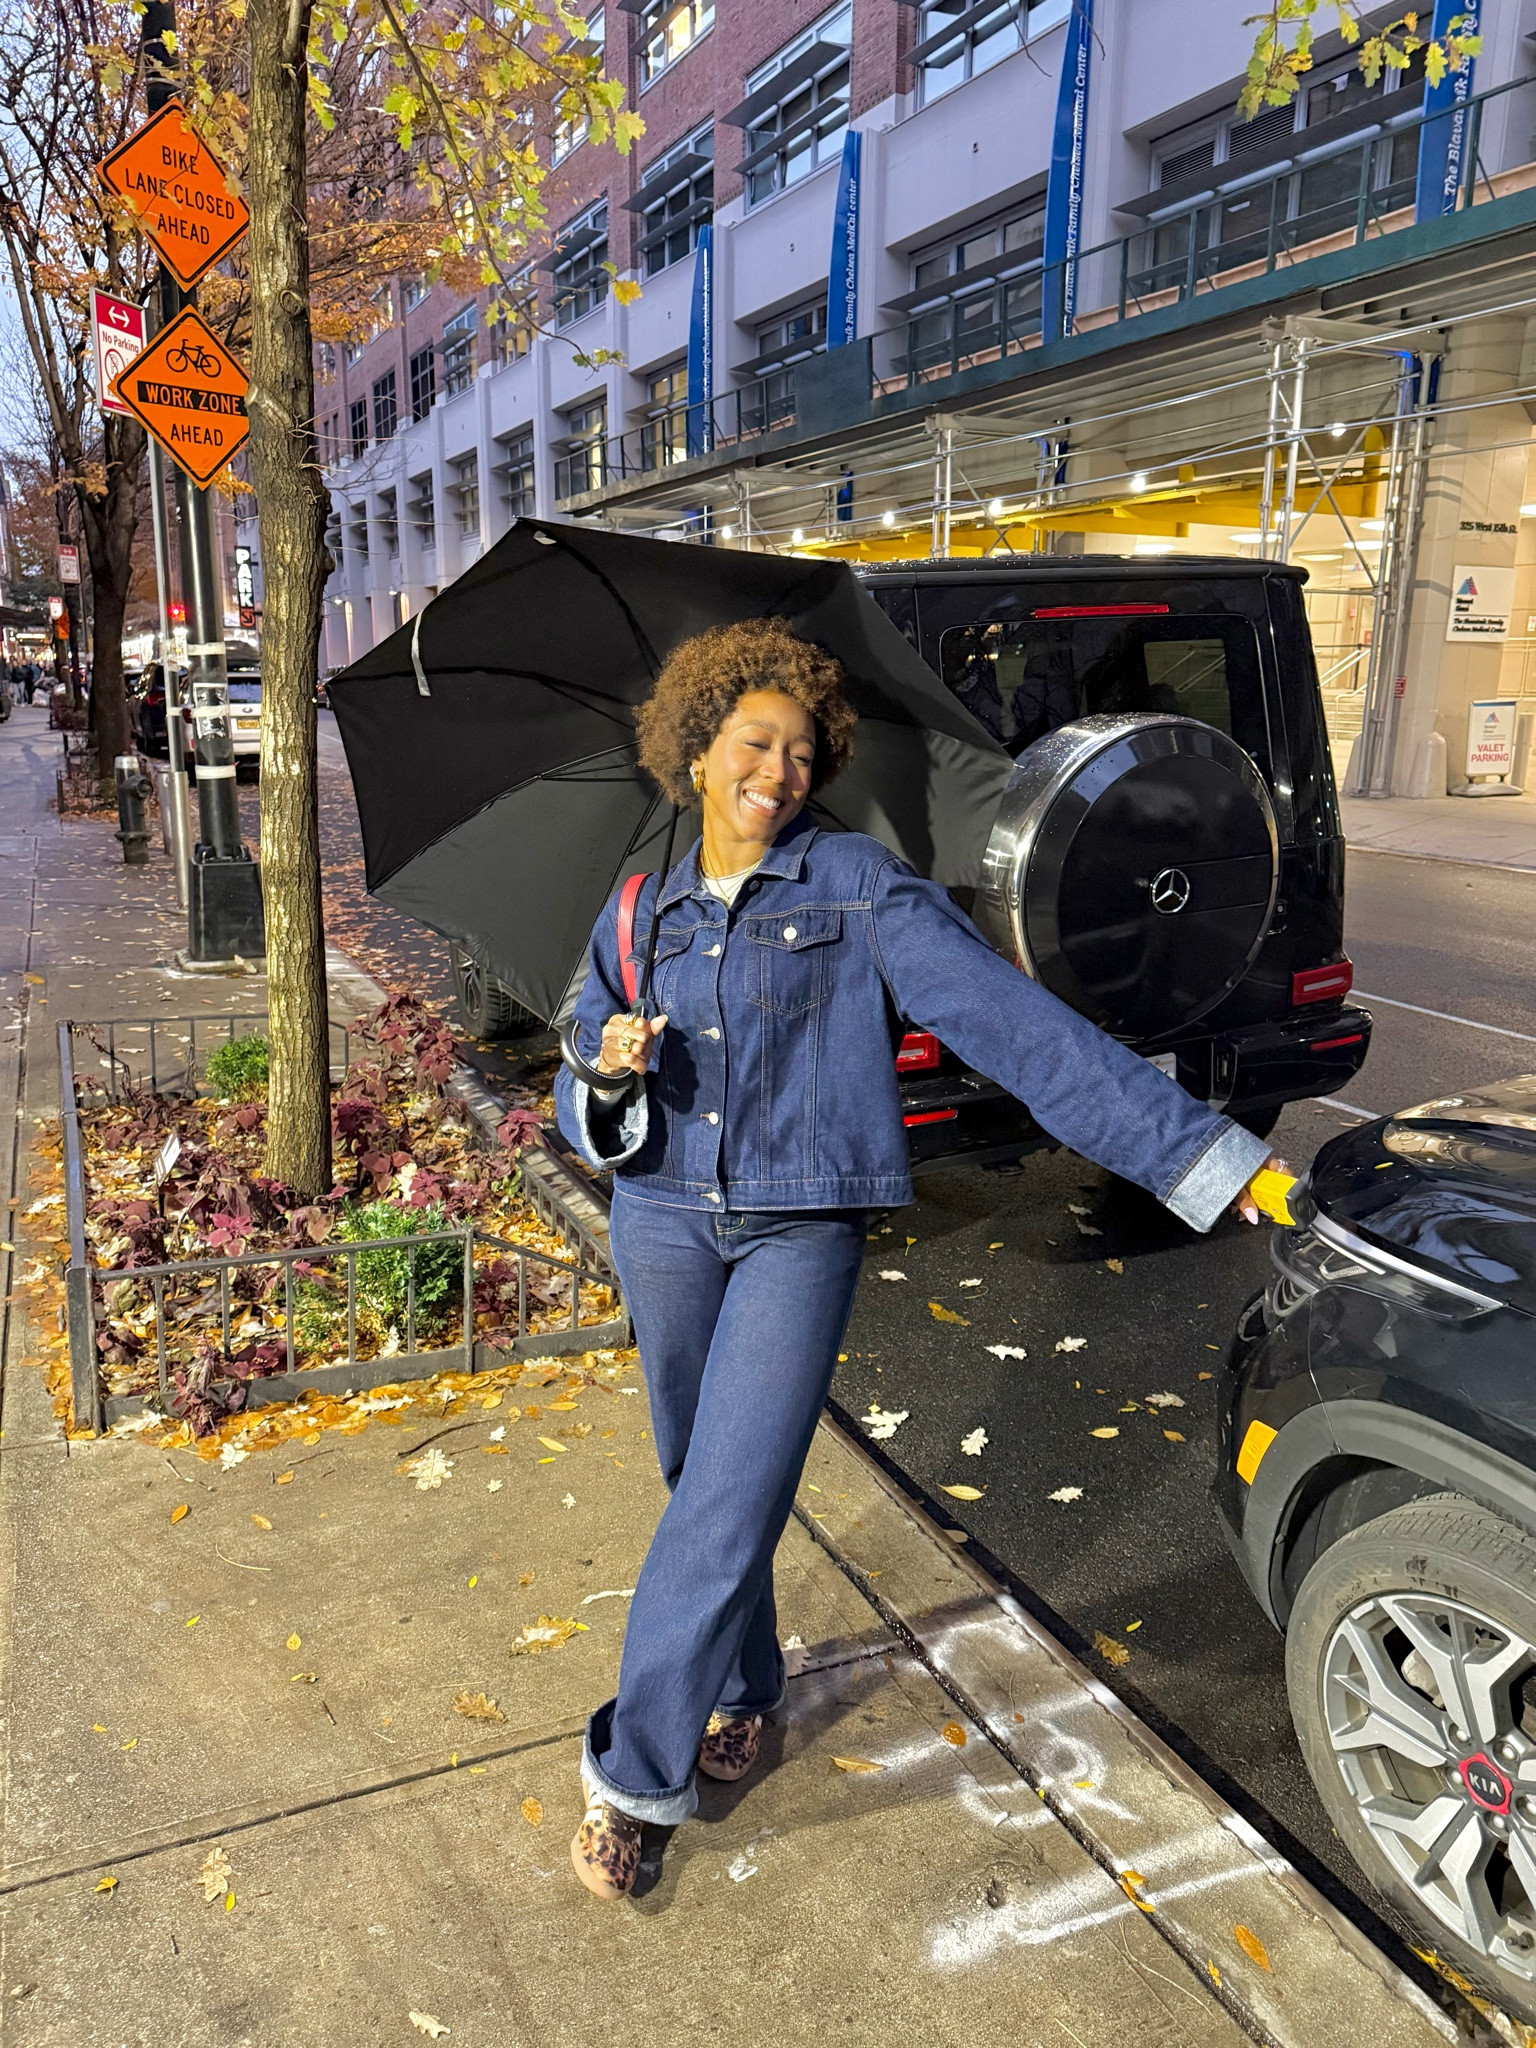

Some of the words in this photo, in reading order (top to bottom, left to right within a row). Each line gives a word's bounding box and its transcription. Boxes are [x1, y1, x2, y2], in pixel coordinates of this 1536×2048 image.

[1076, 44, 1087, 86] Center
[1073, 90, 1084, 140] Medical
[1444, 166, 1458, 197] The
[1457, 14, 1478, 77] Faily
[162, 145, 199, 176] BIKE
[1070, 141, 1082, 189] Chelsea
[125, 168, 169, 199] LANE
[174, 184, 235, 220] CLOSED
[157, 213, 210, 245] AHEAD
[845, 253, 855, 290] Chelsea
[845, 291, 856, 325] Family
[102, 330, 112, 344] No
[113, 335, 139, 355] Parking
[145, 383, 194, 409] WORK
[198, 391, 242, 415] ZONE
[170, 423, 223, 447] AHEAD
[236, 548, 253, 607] PARK
[1471, 753, 1509, 762] PARKING
[1477, 743, 1505, 752] VALET
[1468, 1771, 1503, 1798] KIA
